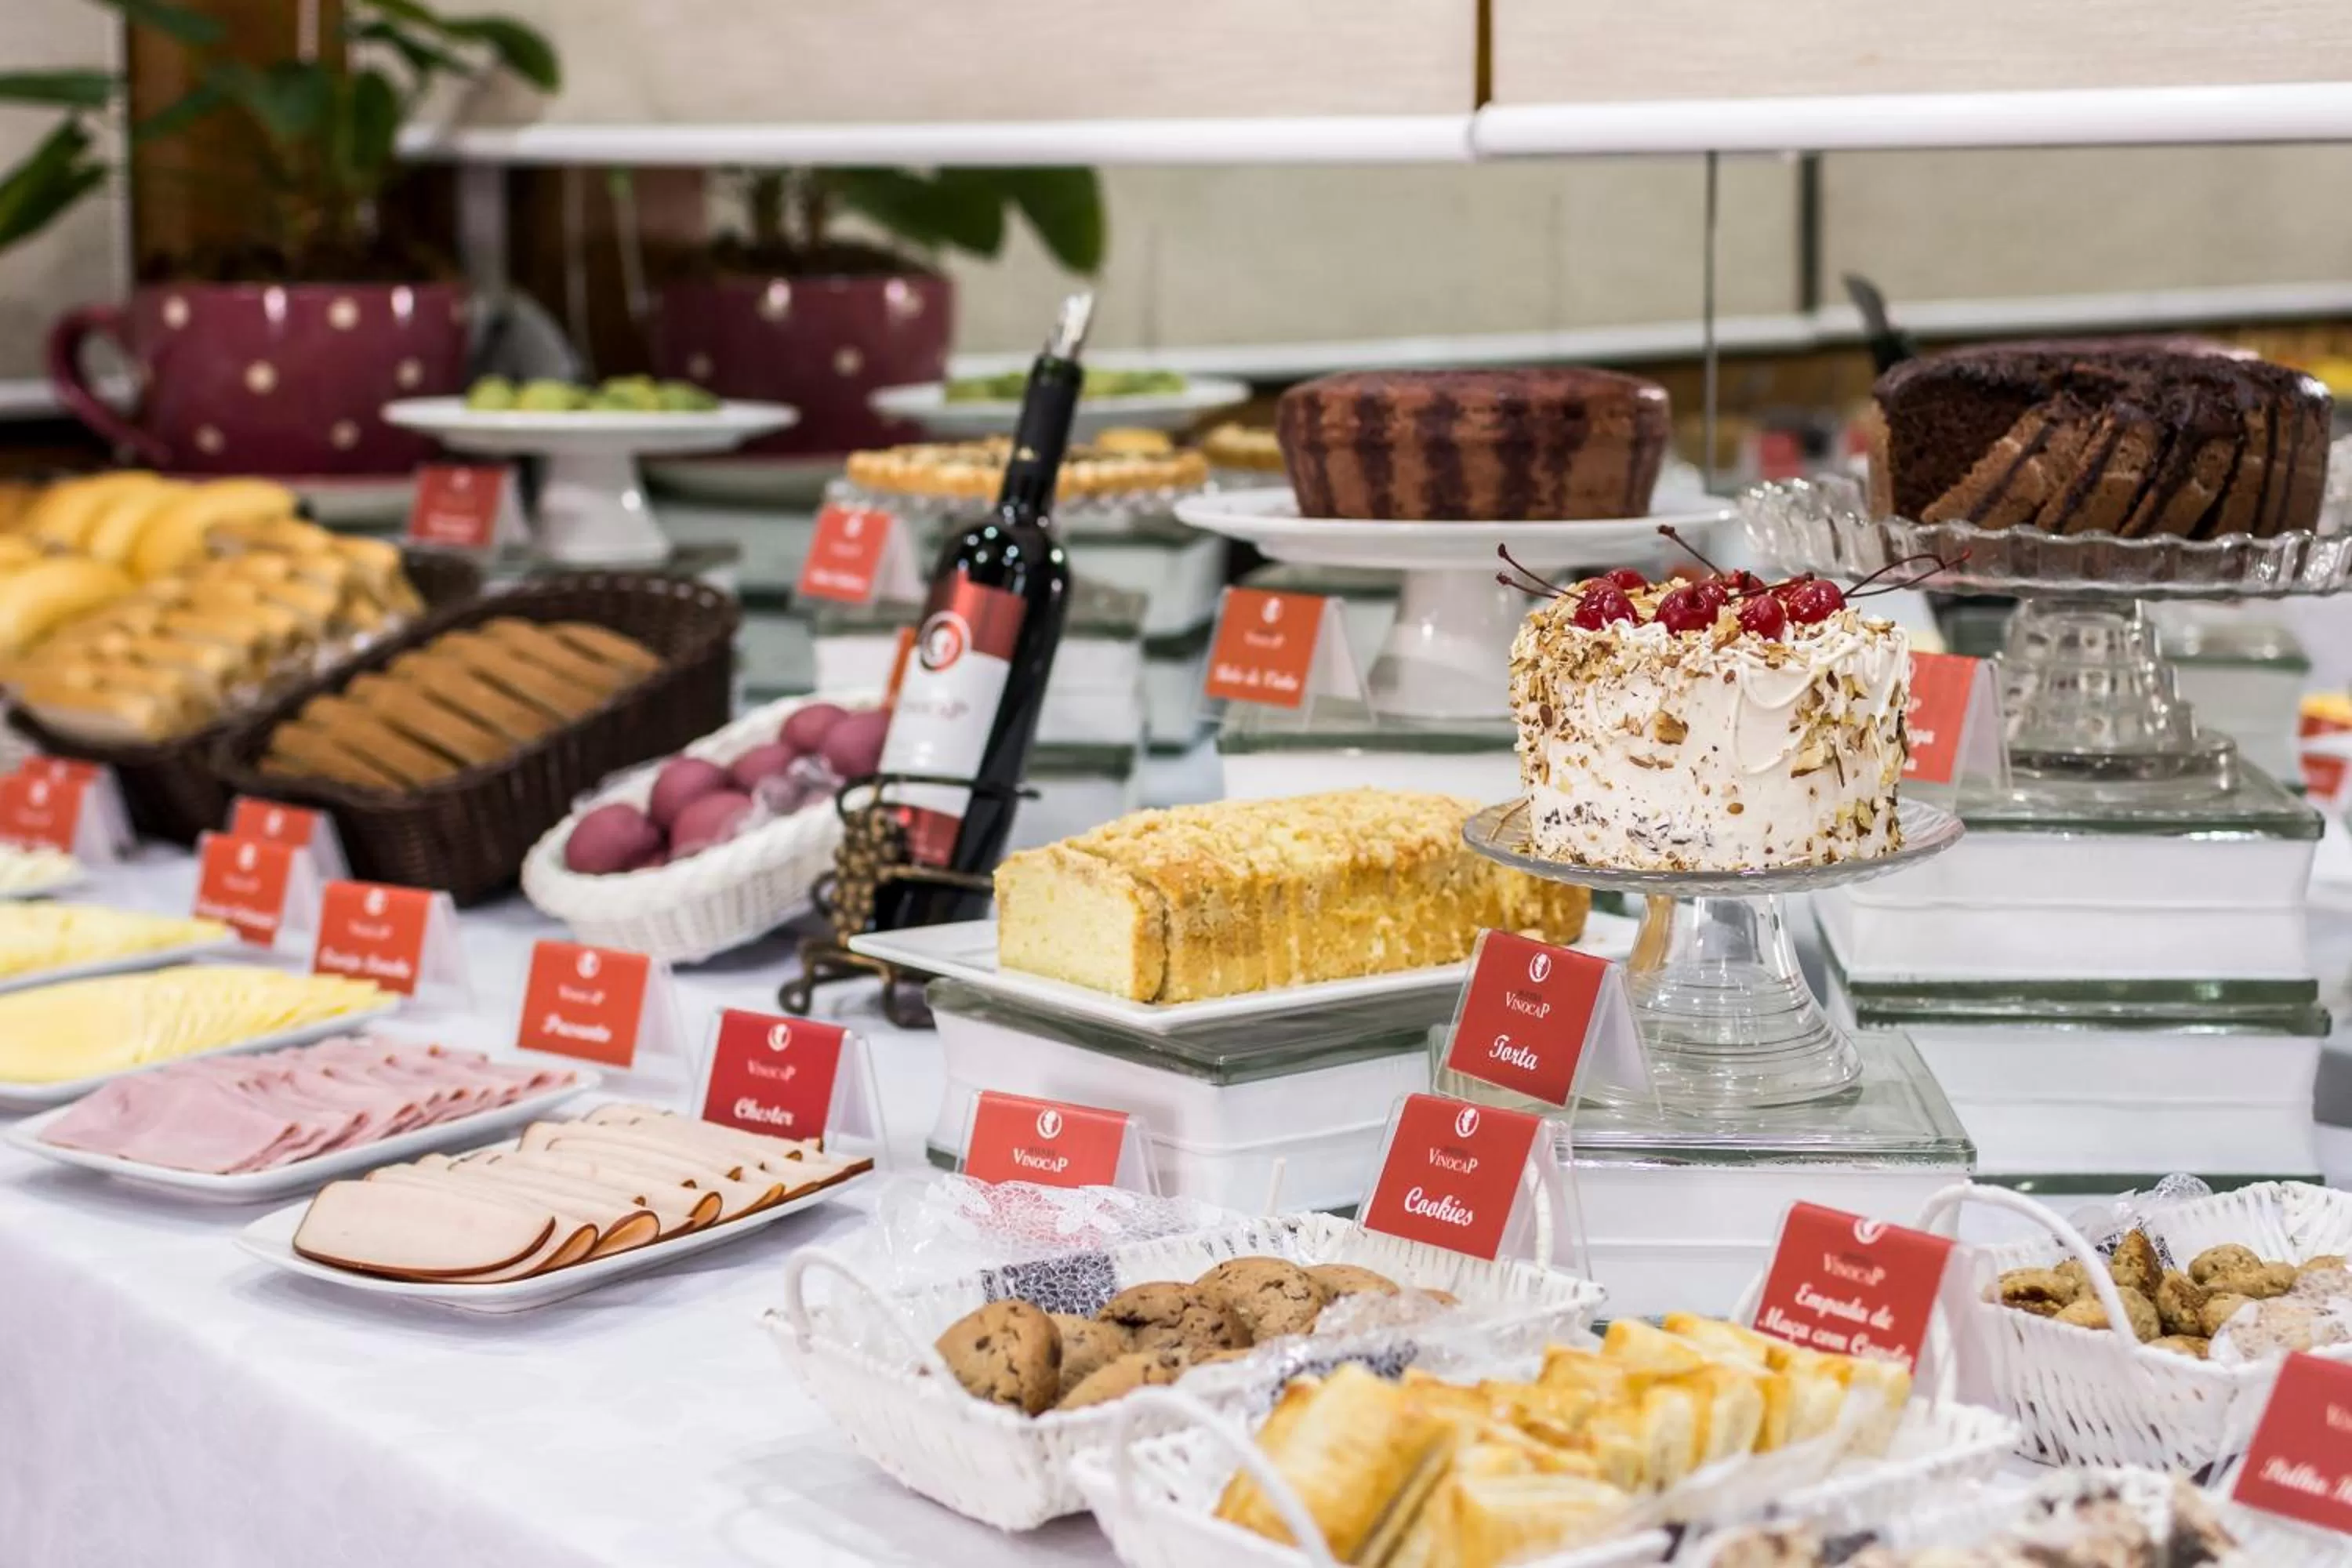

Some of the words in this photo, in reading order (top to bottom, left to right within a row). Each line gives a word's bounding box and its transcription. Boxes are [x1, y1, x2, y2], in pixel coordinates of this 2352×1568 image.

[1489, 1034, 1539, 1070] Torta
[734, 1097, 795, 1127] Chester
[1404, 1185, 1474, 1227] Cookies
[1795, 1282, 1869, 1324] Empada
[1869, 1304, 1895, 1331] de
